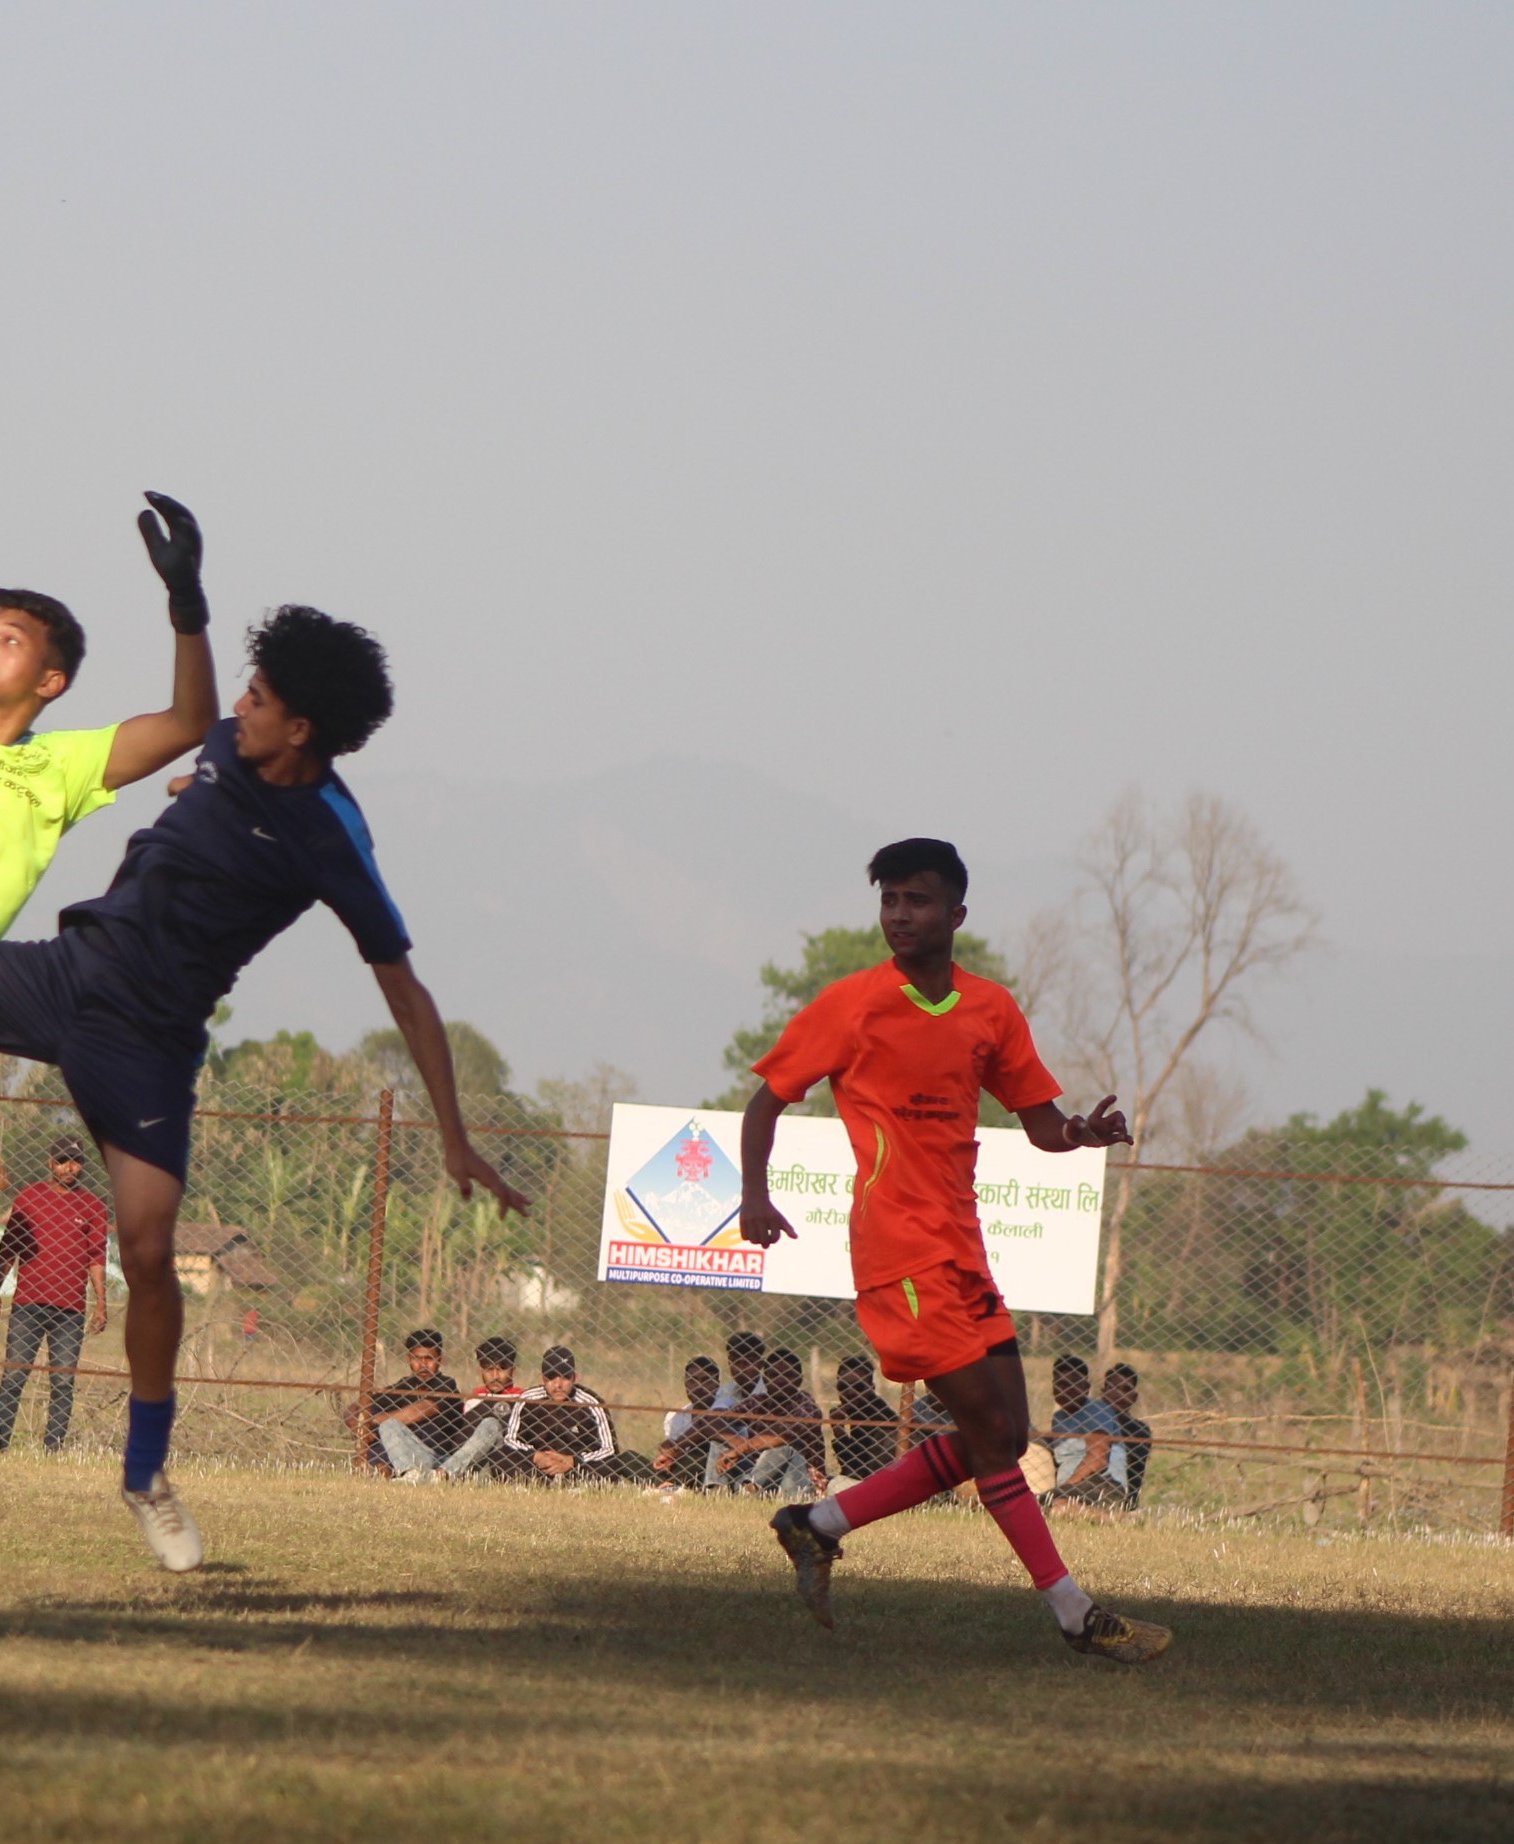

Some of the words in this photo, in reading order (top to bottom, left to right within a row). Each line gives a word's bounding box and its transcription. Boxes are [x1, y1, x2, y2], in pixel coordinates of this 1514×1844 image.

[1025, 1182, 1072, 1210] संस्था
[987, 1219, 1044, 1239] कैलाली
[609, 1244, 763, 1273] HIMSHIKHAR
[608, 1269, 670, 1284] MULTIPURPOSE
[670, 1274, 728, 1287] CO-OPERATIVE
[728, 1278, 761, 1290] LIMITED
